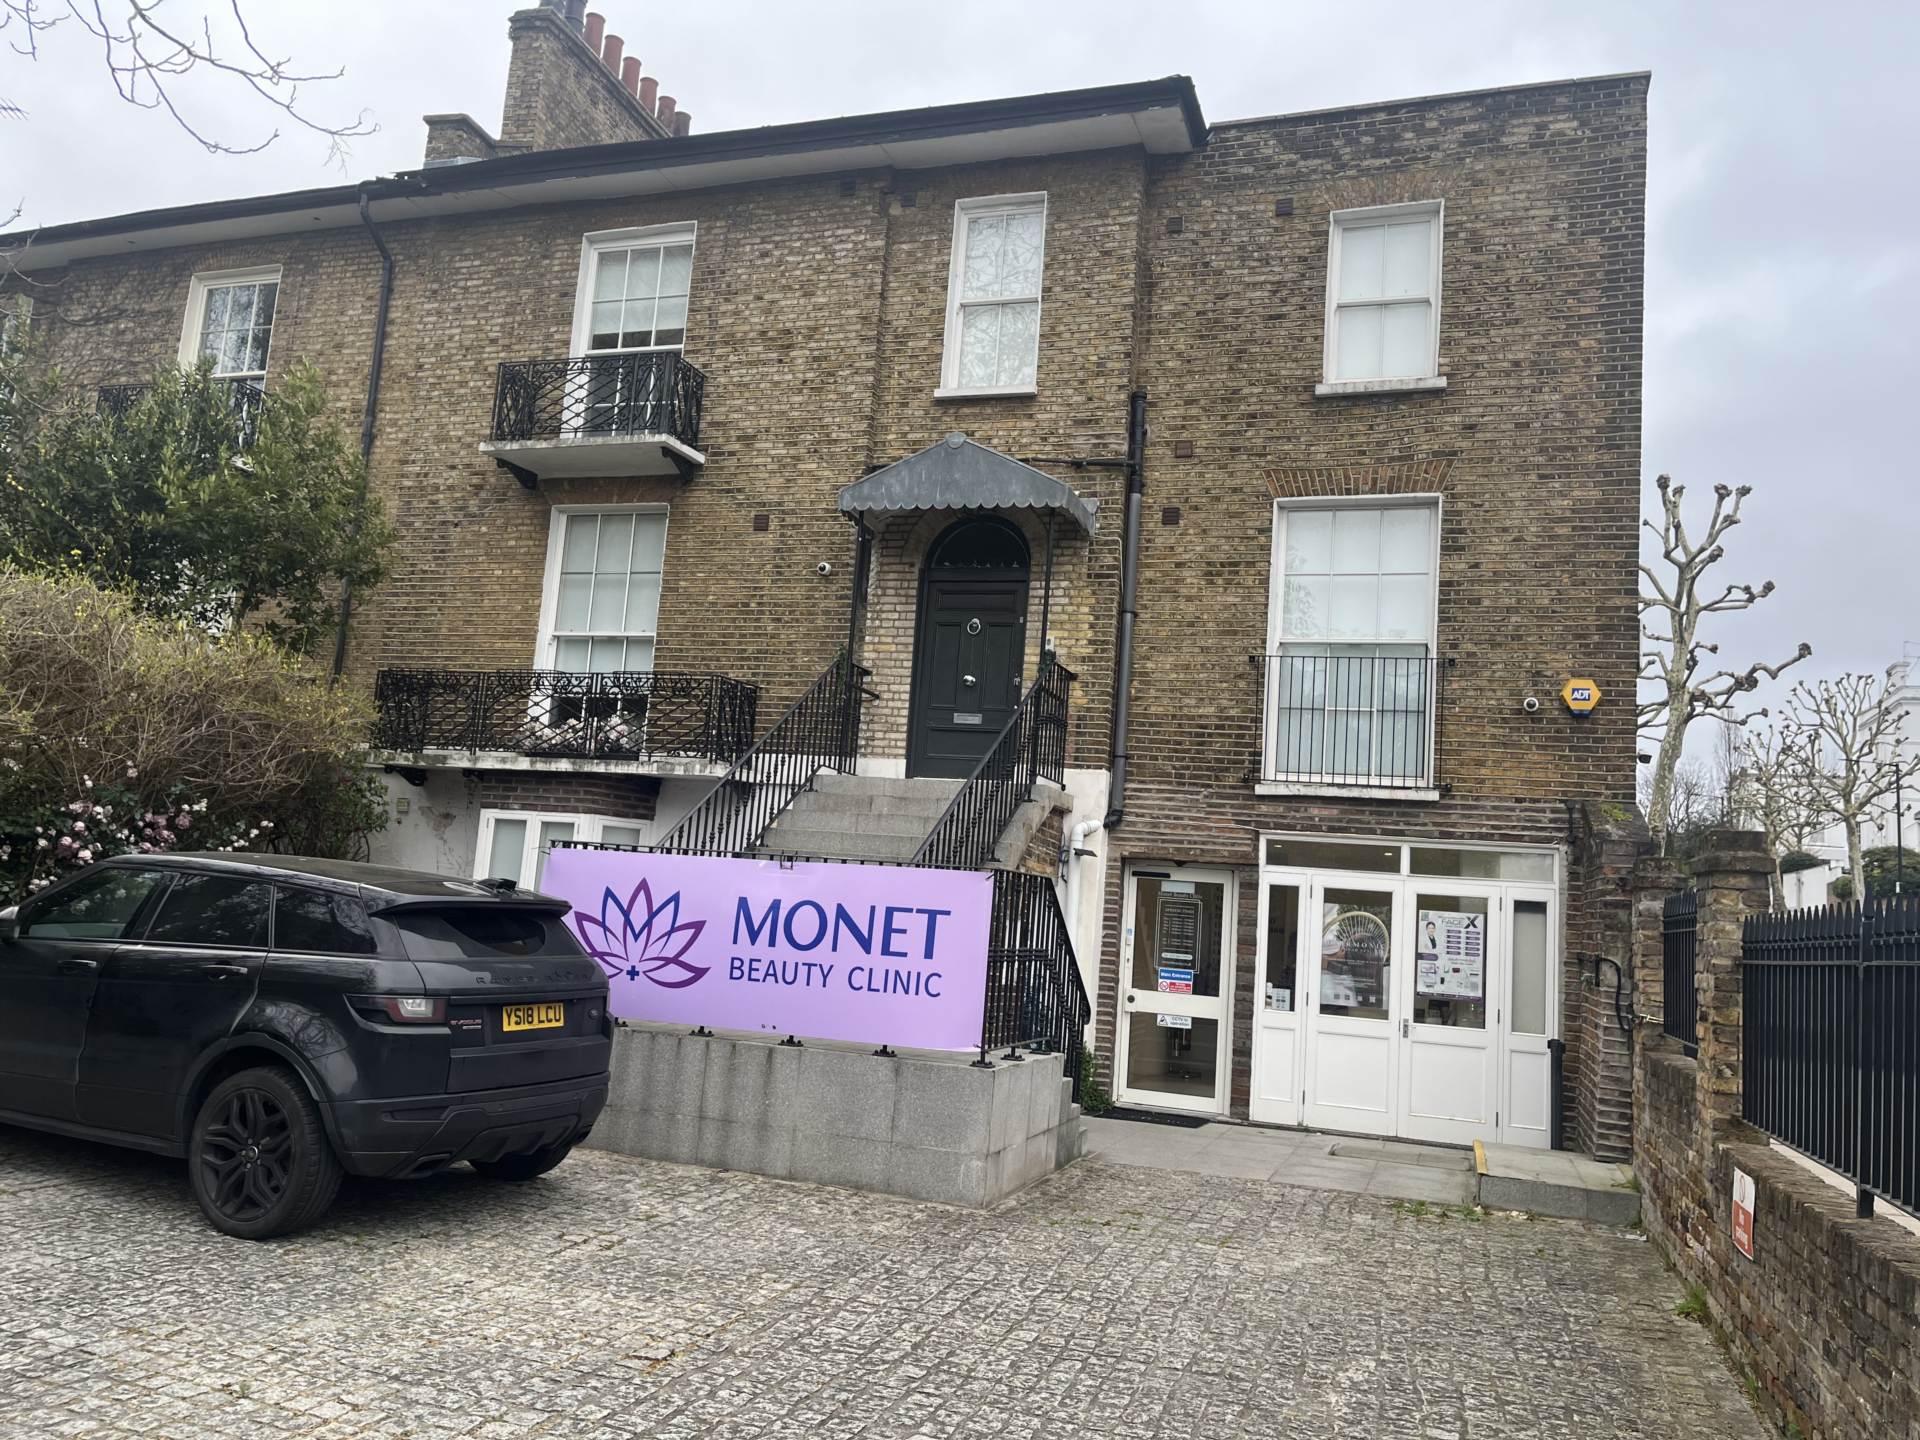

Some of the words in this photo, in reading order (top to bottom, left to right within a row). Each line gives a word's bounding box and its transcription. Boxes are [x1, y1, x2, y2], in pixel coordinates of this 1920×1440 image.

[1572, 690, 1591, 700] ADT
[732, 896, 952, 960] MONET
[729, 956, 835, 988] BEAUTY
[847, 966, 943, 998] CLINIC
[505, 1006, 534, 1027] YS18
[537, 1004, 562, 1024] LCU
